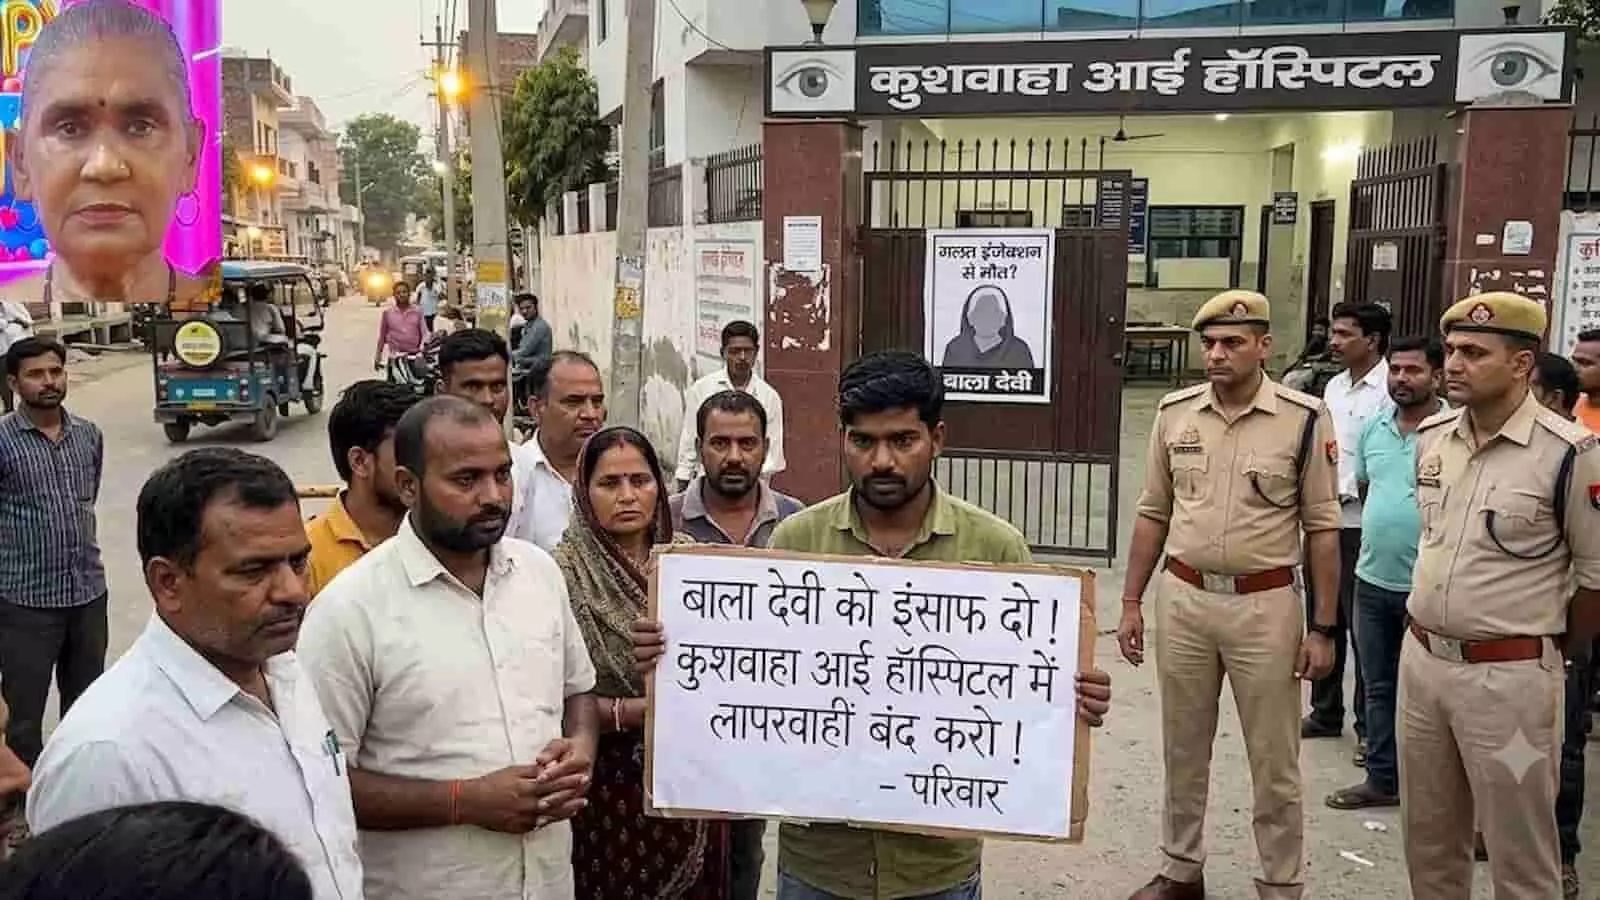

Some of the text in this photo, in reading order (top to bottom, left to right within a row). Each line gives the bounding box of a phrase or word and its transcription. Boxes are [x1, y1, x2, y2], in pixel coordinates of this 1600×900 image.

[869, 45, 1441, 110] कुशवाहा आई हॉस्पिटल
[938, 246, 977, 259] गलत
[961, 262, 975, 280] से
[995, 370, 1033, 391] देवी
[682, 579, 758, 621] बाला
[768, 567, 826, 627] देवी
[835, 571, 879, 628] को
[892, 581, 987, 637] इंसाफ
[1000, 581, 1040, 642] दो
[677, 640, 1060, 703] कुशवाहा आई हॉस्पिटल में
[710, 697, 857, 748] लापरवाहीं
[869, 705, 921, 755] बंद
[934, 704, 1003, 758] करो
[904, 763, 1009, 815] परिवार
